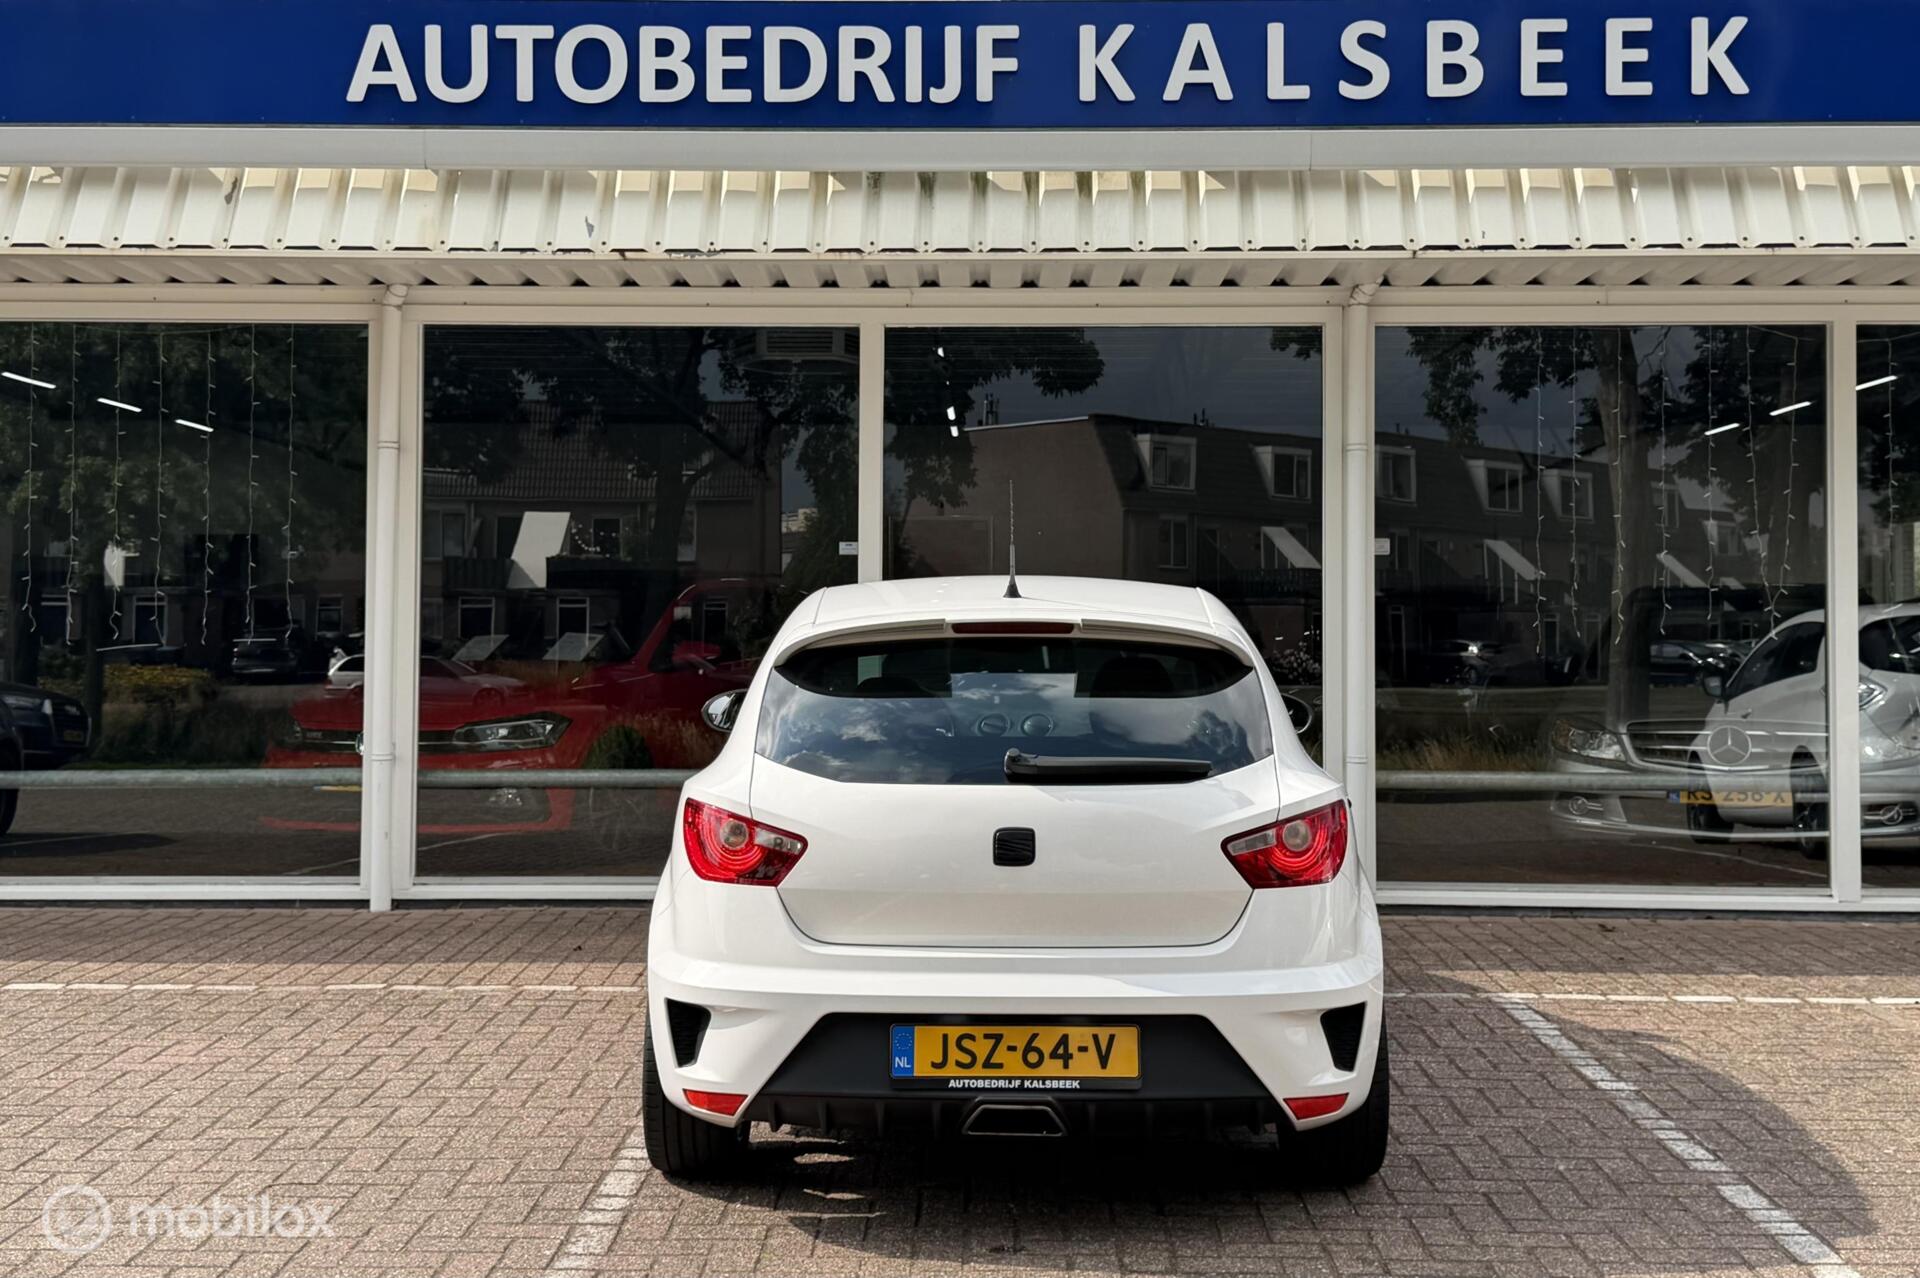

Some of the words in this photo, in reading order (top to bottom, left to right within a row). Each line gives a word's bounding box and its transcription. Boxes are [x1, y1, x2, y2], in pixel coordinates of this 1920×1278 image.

[346, 23, 1020, 104] AUTOBEDRIJF
[1079, 16, 1750, 102] KALSBEEK
[894, 1056, 911, 1068] NL
[930, 1032, 1116, 1070] JSZ-64-V
[948, 1079, 1022, 1089] AUTOBEDRIJF
[1024, 1079, 1080, 1089] KALSBEEK
